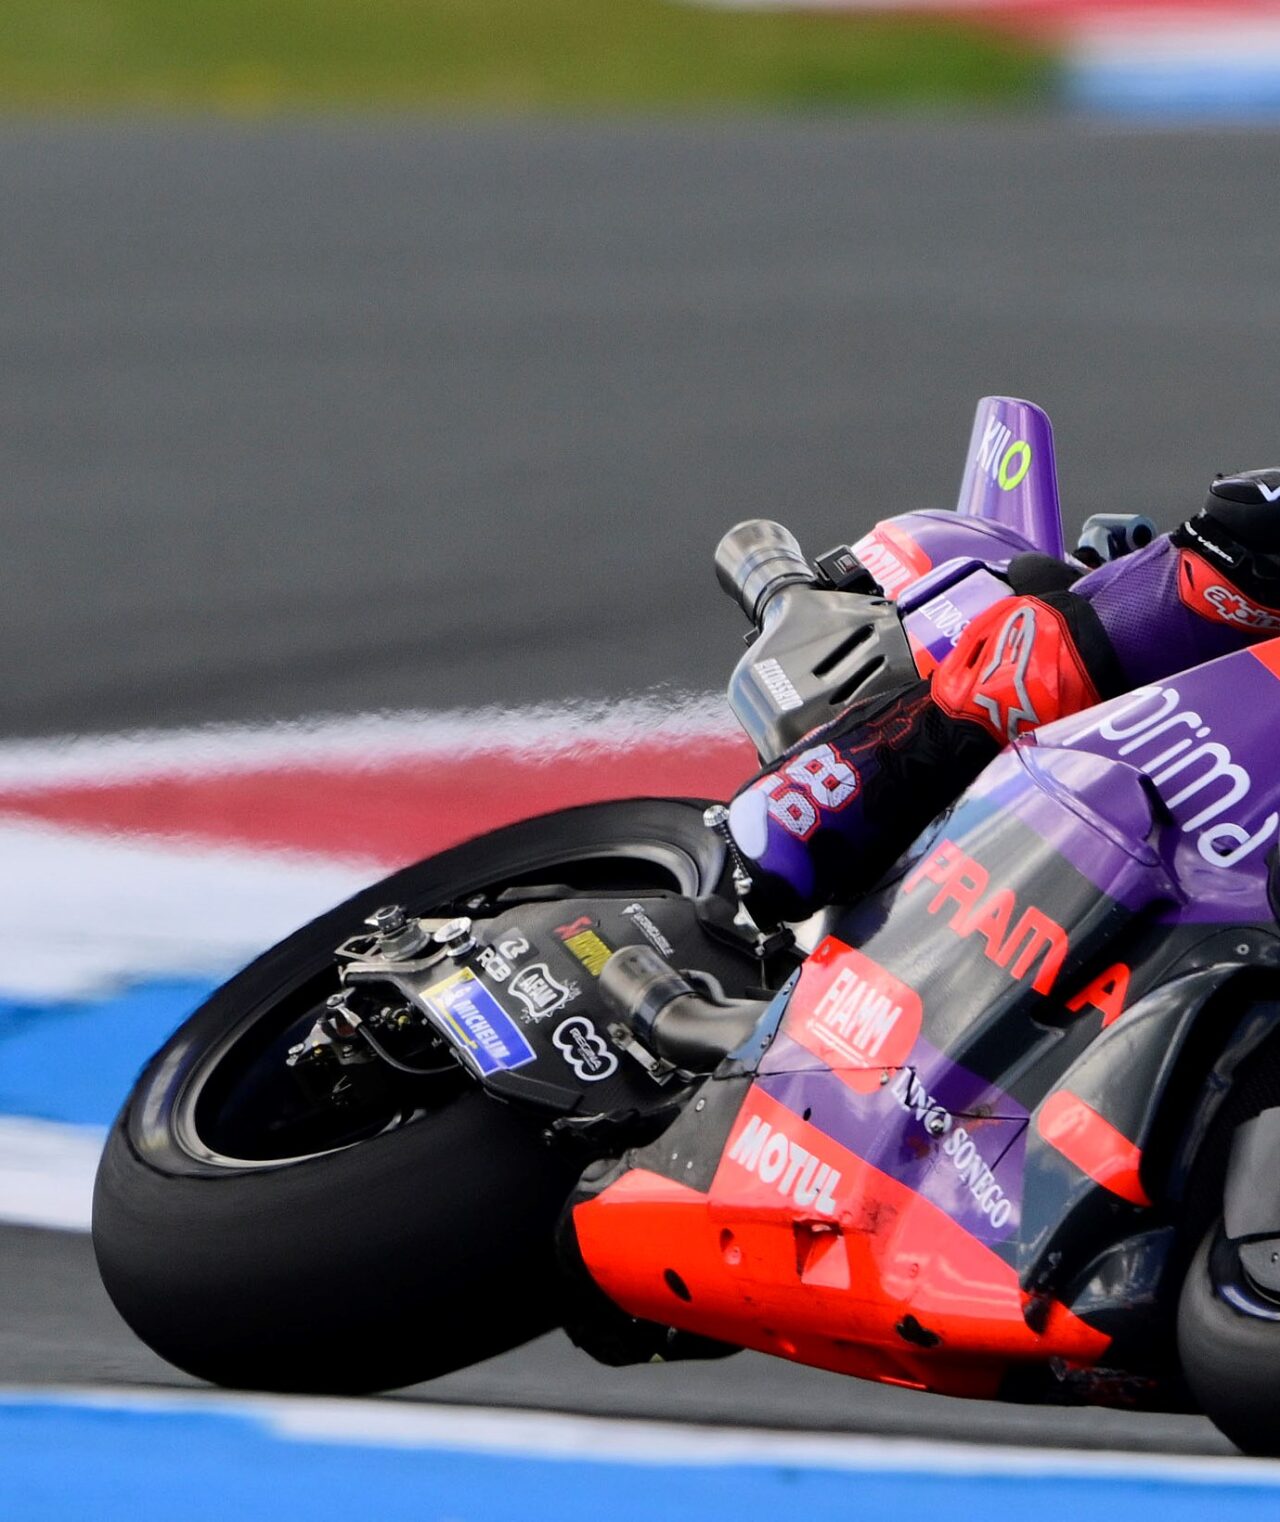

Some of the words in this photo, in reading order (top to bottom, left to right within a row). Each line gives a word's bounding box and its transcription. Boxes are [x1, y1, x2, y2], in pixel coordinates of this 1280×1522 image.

[1063, 685, 1279, 870] prima
[476, 947, 512, 982] RCB
[904, 839, 1132, 1028] PRAMA
[453, 999, 511, 1060] MICHELIN
[519, 973, 558, 1007] AFAM
[813, 967, 904, 1058] FIAMM
[727, 1115, 843, 1215] MOTUL
[943, 1127, 1011, 1228] SONEGO
